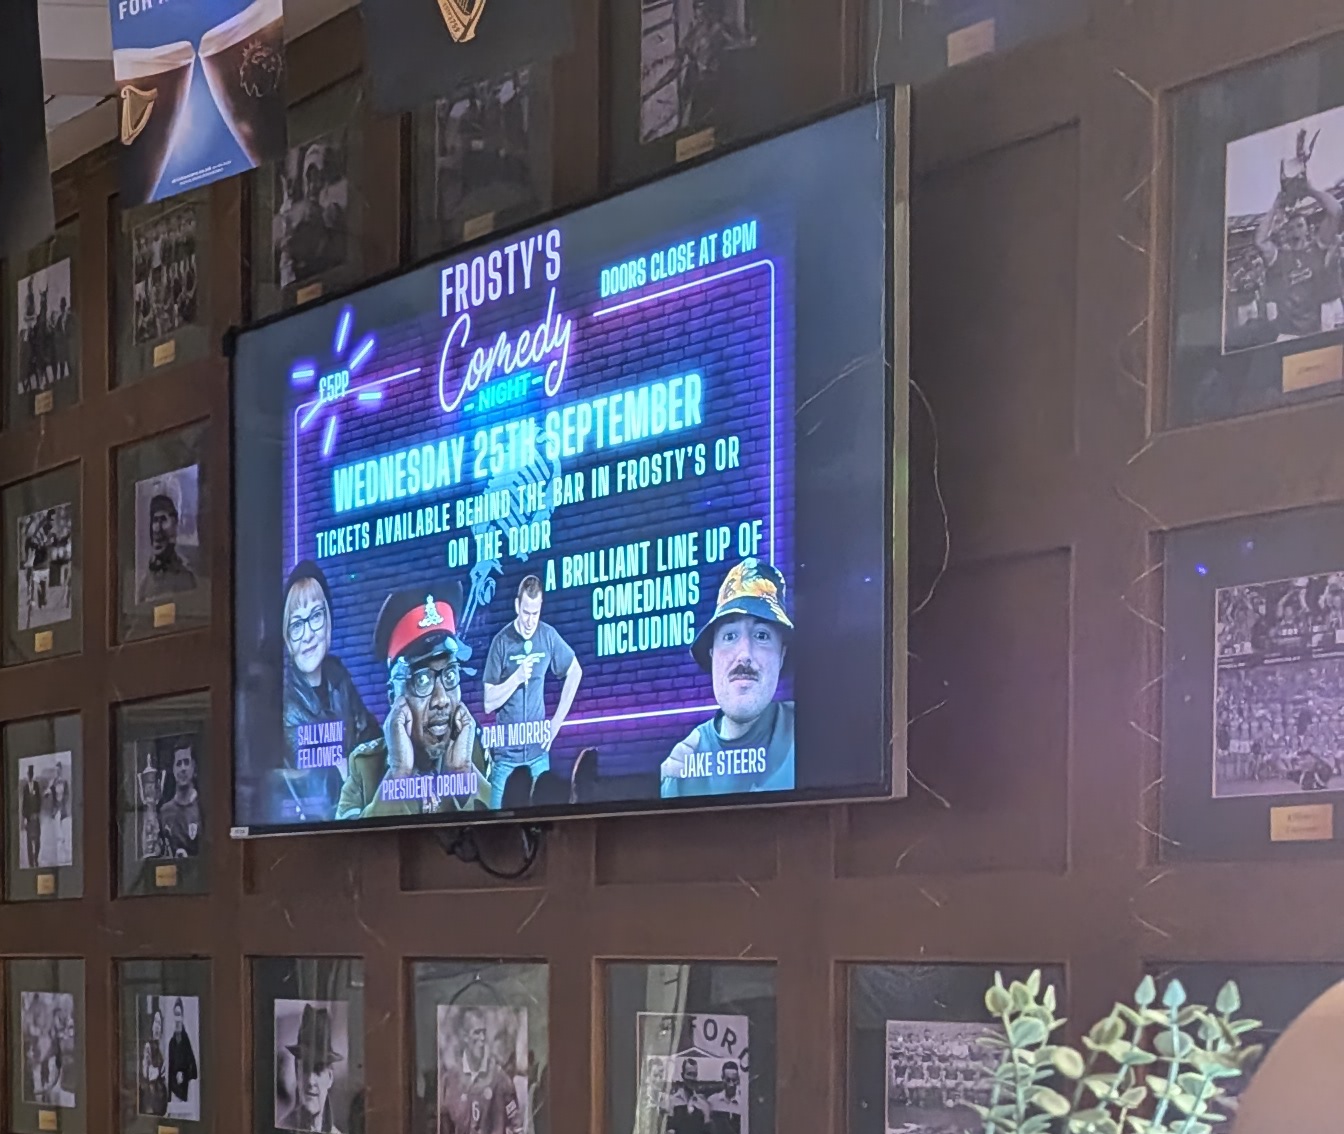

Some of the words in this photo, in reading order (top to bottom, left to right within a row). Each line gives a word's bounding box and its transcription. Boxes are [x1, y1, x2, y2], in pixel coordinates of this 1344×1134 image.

[441, 229, 562, 316] FROSTY'S
[601, 264, 647, 297] DOORS
[650, 248, 697, 285] CLOSE
[700, 237, 719, 266] AT
[722, 221, 758, 258] 8PM
[439, 288, 571, 413] Comedy
[319, 370, 349, 403] £5PP
[478, 375, 531, 411] NIGHT
[334, 438, 464, 513] WEDNESDAY
[473, 417, 538, 479] 25TH
[545, 373, 702, 462] SEPTEMBER
[316, 523, 370, 558] TICKETS
[375, 502, 450, 548] AVAILABLE
[456, 490, 510, 532] BEHIND
[517, 480, 546, 510] THE
[553, 471, 583, 506] BAR
[592, 470, 609, 498] IN
[617, 442, 707, 491] FROSTY'S
[715, 436, 740, 471] OR
[448, 538, 470, 568] ON
[477, 531, 503, 561] THE
[508, 521, 552, 554] DOOR
[545, 563, 556, 591] A
[563, 541, 648, 588] BRILLIANT
[657, 534, 697, 572] LINE
[705, 530, 731, 561] UP
[738, 521, 763, 556] OF
[592, 572, 700, 621] COMEDIANS
[597, 611, 695, 656] INCLUDING
[297, 720, 343, 748] SALLYANN
[483, 724, 505, 748] DAN
[508, 720, 551, 746] MORRIS
[297, 744, 343, 770] FELLOWES
[679, 752, 712, 779] JAKE
[716, 747, 767, 776] STEERS
[382, 776, 433, 800] PRESIDENT
[436, 772, 478, 797] OBONJO
[472, 1101, 480, 1121] 6
